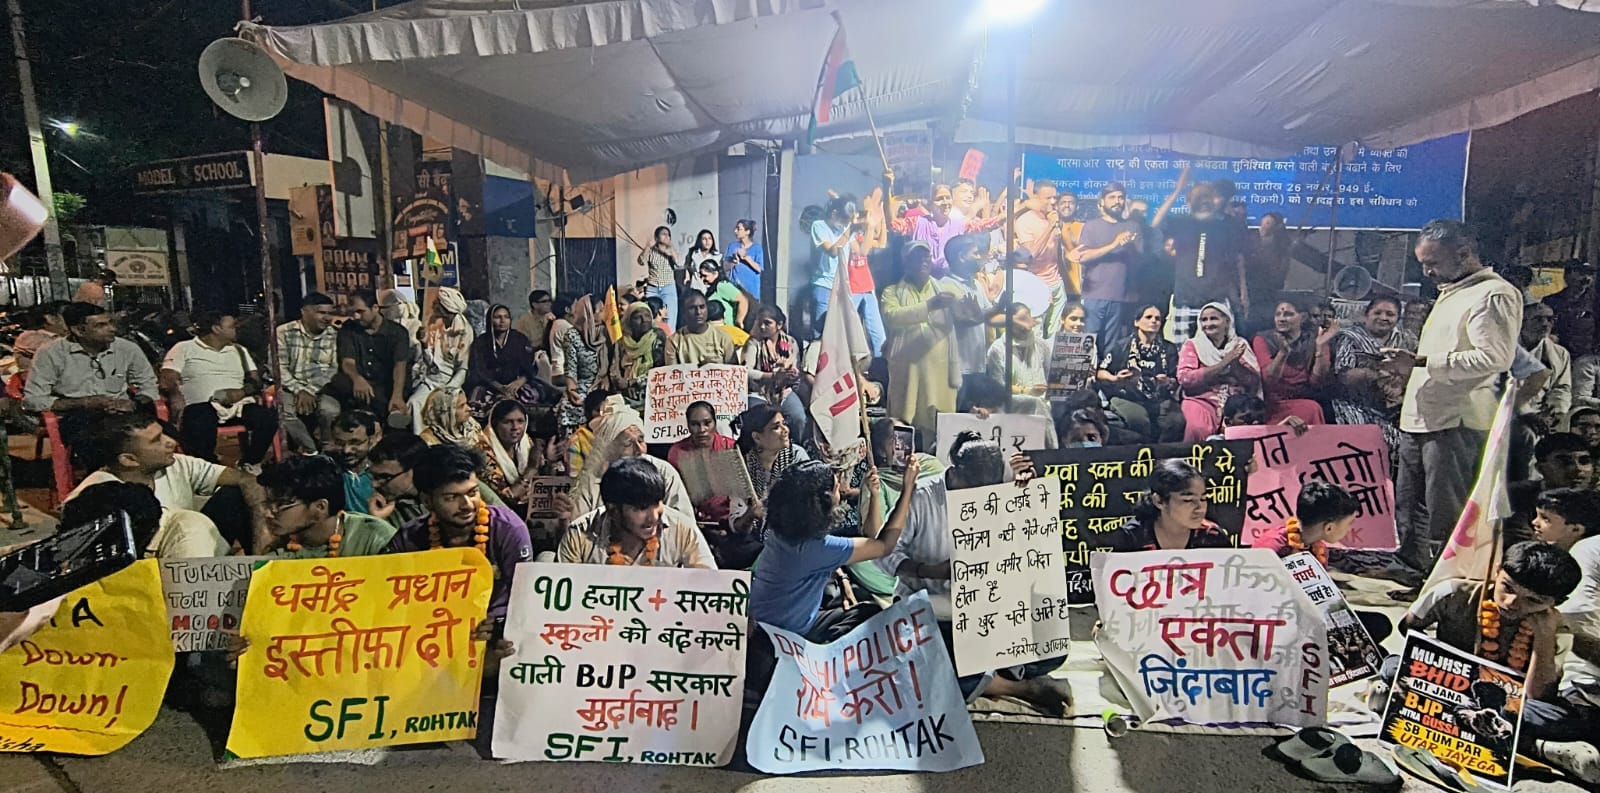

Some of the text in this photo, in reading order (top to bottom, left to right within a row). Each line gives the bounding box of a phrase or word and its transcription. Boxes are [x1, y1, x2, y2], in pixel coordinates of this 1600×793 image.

[193, 161, 243, 182] SCHOOL
[1286, 183, 1302, 193] 26
[1081, 482, 1109, 509] की
[165, 561, 253, 584] TUMN
[1109, 562, 1215, 610] छात्र
[168, 590, 208, 609] TOH
[386, 567, 477, 610] प्रधान
[581, 584, 645, 613] हजार
[673, 577, 750, 618] सरकारी
[172, 613, 238, 631] MOOD
[539, 615, 615, 652] स्कूलों
[618, 618, 651, 645] को
[694, 623, 746, 652] करने
[171, 631, 230, 653] KHAR
[842, 607, 933, 678] POLICE
[1158, 617, 1288, 662] एकता
[509, 655, 738, 698] वाली BJP सरकार
[1409, 661, 1471, 693] BHID
[1410, 646, 1474, 679] MUJHSE
[1138, 653, 1278, 709] जिंदाबाद
[1411, 679, 1463, 704] MT JANA
[14, 680, 129, 729] Down!
[1404, 692, 1444, 717] BJP
[404, 711, 477, 734] ROHTAK
[844, 712, 955, 762] ROHTAK
[1421, 714, 1460, 737] GUSSA
[1399, 732, 1439, 754] UTAR
[1403, 721, 1483, 758] SB TUM PAR
[640, 750, 717, 765] ROHTAK
